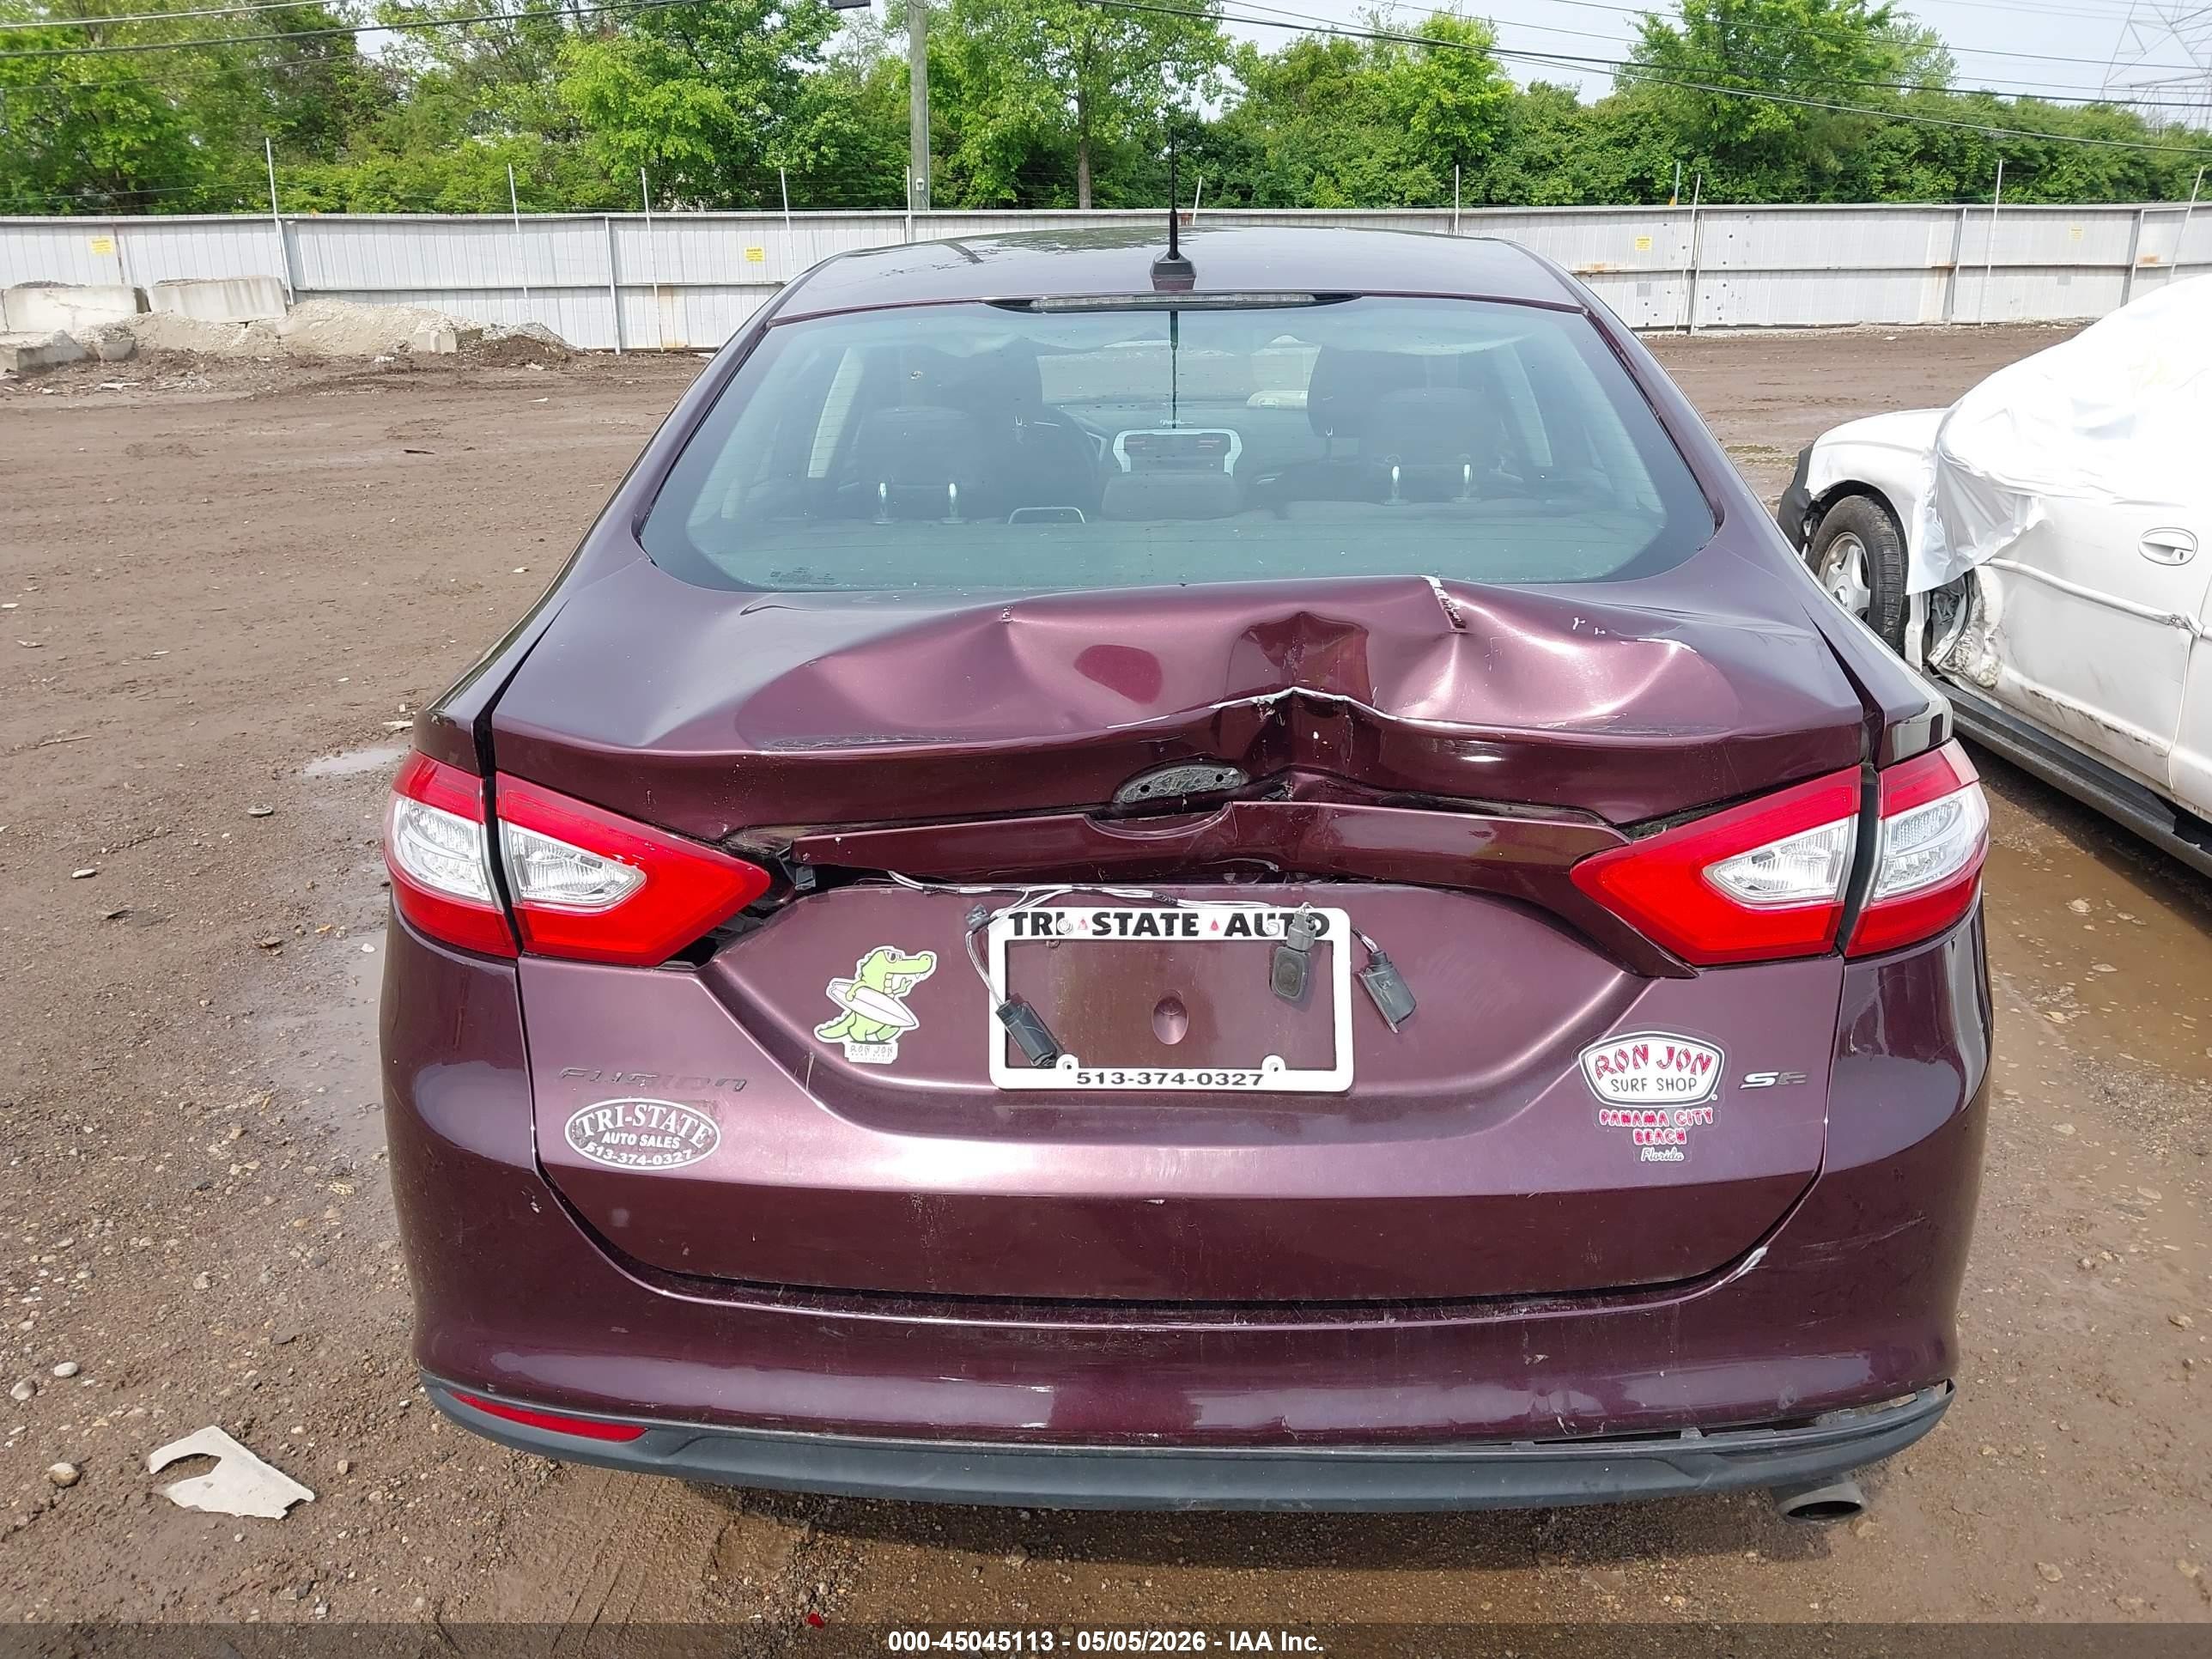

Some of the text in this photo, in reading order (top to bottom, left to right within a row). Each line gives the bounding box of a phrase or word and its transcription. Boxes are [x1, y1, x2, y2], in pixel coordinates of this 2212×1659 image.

[1009, 912, 1065, 936] TRI
[1092, 912, 1200, 937] STATE
[1595, 1044, 1712, 1079] RON JON
[1077, 1072, 1264, 1087] 513-374-0327
[1611, 1076, 1697, 1092] SURF SHOP
[576, 1104, 713, 1149] TRI-STATE
[1600, 1107, 1713, 1127] PANAMA CITY
[602, 1132, 681, 1149] AUTO SALES
[1633, 1127, 1686, 1145] BEACH
[586, 1142, 692, 1165] 513-374-0327
